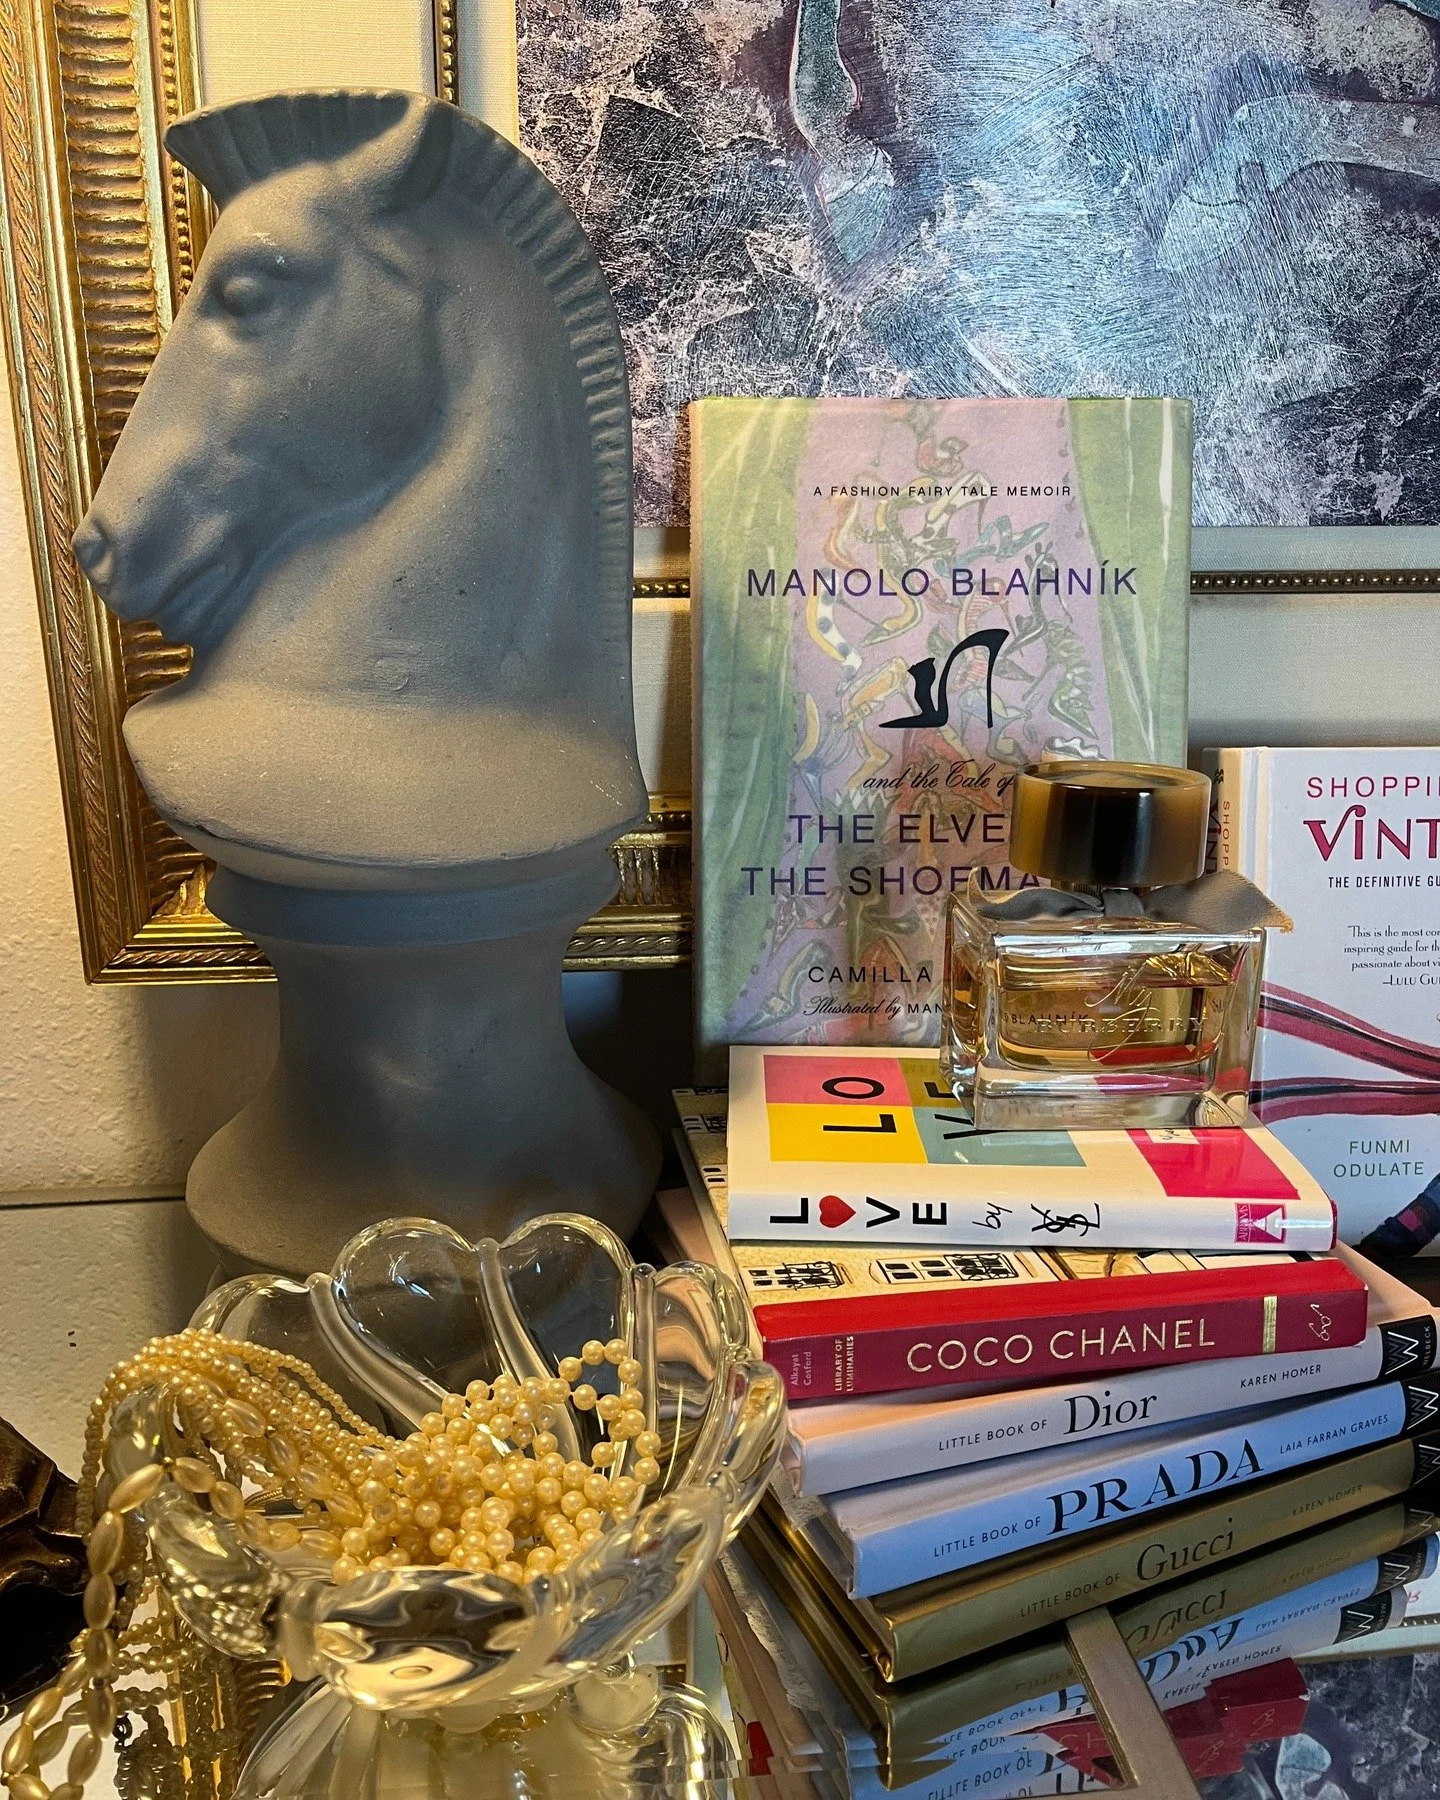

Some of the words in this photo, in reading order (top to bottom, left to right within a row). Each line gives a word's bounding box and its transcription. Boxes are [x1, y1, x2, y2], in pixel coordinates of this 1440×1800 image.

[813, 486, 823, 497] A
[830, 485, 901, 497] FASHION
[907, 485, 953, 497] FAIRY
[961, 485, 998, 497] TALE
[1007, 485, 1072, 497] MEMOIR
[747, 568, 930, 598] MANOLO
[951, 559, 1138, 597] BLAHNÍK
[863, 767, 909, 789] and
[911, 763, 940, 789] the
[946, 759, 996, 789] Tale
[1307, 776, 1440, 798] SHOPPI
[789, 814, 875, 844] THE
[899, 813, 1005, 843] ELVE
[741, 866, 827, 896] THE
[849, 865, 1041, 896] SHOEMA
[1328, 876, 1349, 888] THE
[1356, 875, 1421, 888] DEFINITIVE
[1348, 925, 1371, 937] This
[1374, 927, 1382, 937] is
[1385, 925, 1399, 937] the
[1401, 928, 1423, 937] most
[1344, 943, 1385, 956] inspiring
[1387, 940, 1413, 956] guide
[1416, 940, 1430, 952] for
[808, 966, 932, 983] CAMILLA
[1351, 958, 1402, 971] passionate
[1404, 955, 1430, 968] about
[803, 995, 884, 1016] Illustrated
[885, 996, 901, 1020] by
[1035, 1017, 1206, 1034] BURBERRY
[1349, 1139, 1410, 1155] FUNMI
[1333, 1161, 1424, 1178] ODULATE
[972, 1202, 1013, 1230] by
[835, 1338, 843, 1352] OF
[906, 1334, 1033, 1374] COCO
[1050, 1318, 1215, 1360] CHANEL
[790, 1353, 800, 1386] Alkayat
[804, 1350, 812, 1386] Cosford
[835, 1353, 843, 1391] LIBRARY
[846, 1336, 854, 1392] LUMINARIES
[938, 1433, 980, 1451] LITTLE
[987, 1424, 1024, 1441] BOOK
[1030, 1419, 1048, 1432] OF
[1064, 1390, 1158, 1435] Dior
[1239, 1373, 1278, 1389] KAREN
[1282, 1364, 1322, 1383] HOMER
[934, 1535, 975, 1558] LITTLE
[982, 1523, 1018, 1543] BOOK
[1024, 1516, 1042, 1530] OF
[1046, 1438, 1264, 1537] PRADA
[1279, 1440, 1303, 1454] LAIA
[1307, 1427, 1347, 1447] FARRAN
[1350, 1413, 1389, 1433] GRAVES
[1020, 1594, 1060, 1618] LITTLE
[1065, 1581, 1100, 1600] BOOK
[1104, 1572, 1121, 1587] OF
[1136, 1517, 1235, 1582] Gucci
[1291, 1499, 1325, 1517] KAREN
[1328, 1484, 1363, 1503] HOMER
